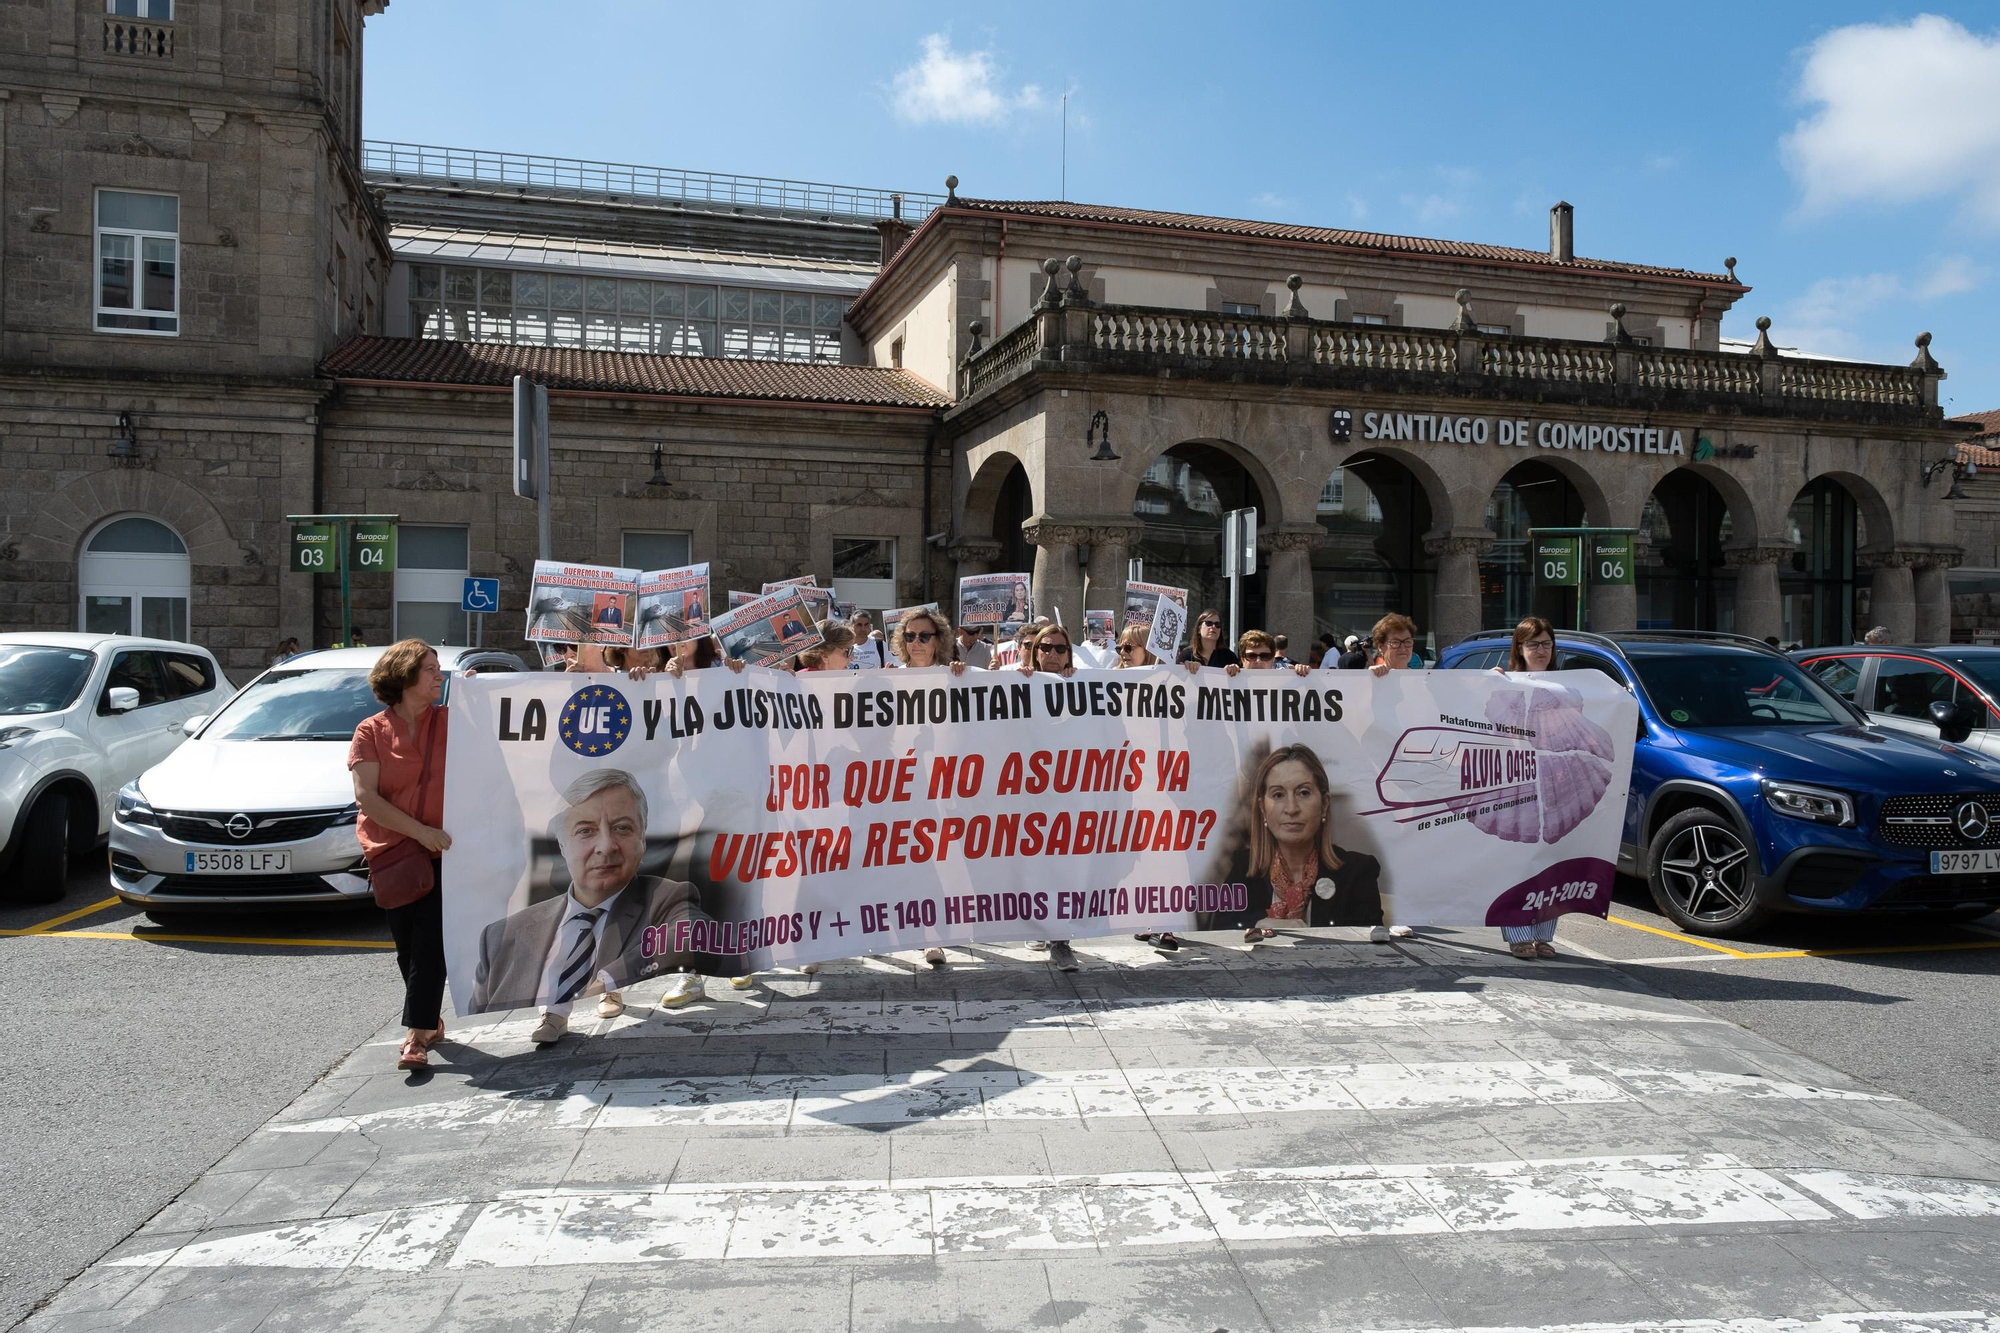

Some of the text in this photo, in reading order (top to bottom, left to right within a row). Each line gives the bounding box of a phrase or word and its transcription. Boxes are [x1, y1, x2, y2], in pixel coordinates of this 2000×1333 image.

[1364, 412, 1685, 456] SANTIAGO DE COMPOSTELA
[296, 533, 330, 542] Europcar
[356, 532, 390, 542] Europcar
[300, 548, 324, 566] 03
[360, 548, 384, 565] 04
[1539, 546, 1571, 555] Europcar
[1596, 546, 1628, 555] Europcar
[563, 567, 614, 579] QUEREMOS UNA
[658, 571, 684, 582] QUEREMOS
[1544, 561, 1568, 579] 05
[1601, 561, 1625, 579] 06
[588, 581, 637, 592] INDEPENDIENTE
[1128, 582, 1152, 592] MENTIRAS
[734, 596, 777, 619] QUEREMOS UNA
[758, 595, 801, 618] INDEPENDIENTE
[962, 602, 1007, 613] ANA PASTOR
[1125, 610, 1154, 623] ANA PAS
[531, 628, 540, 636] 81
[541, 629, 581, 639] FALLECIDOS
[603, 632, 631, 643] HERIDOS
[640, 637, 647, 645] 81
[648, 632, 679, 643] FALLECIDOS
[796, 634, 820, 649] HERIDOS
[498, 681, 1343, 742] LA UE Y LA JUSTICIA DESMONTAN VUESTRAS MENTIRAS
[1440, 713, 1537, 738] Plataforma Víctimas
[766, 740, 1190, 813] ¿POR QUÉ NO ASUMÍS YA
[1461, 748, 1537, 791] ALVIA 04155
[1417, 794, 1538, 831] de Santiago de Compostela
[708, 809, 1217, 884] VUESTRA RESPONSABILIDAD?
[198, 854, 244, 870] 5508
[250, 854, 286, 870] LFJ
[1941, 854, 1980, 870] 9797
[1522, 881, 1599, 911] 24-7-2013
[640, 883, 1249, 959] 81 FALLECIDOS Y + DE 140 HERIDOS EN ALTA VELOCIDAD
